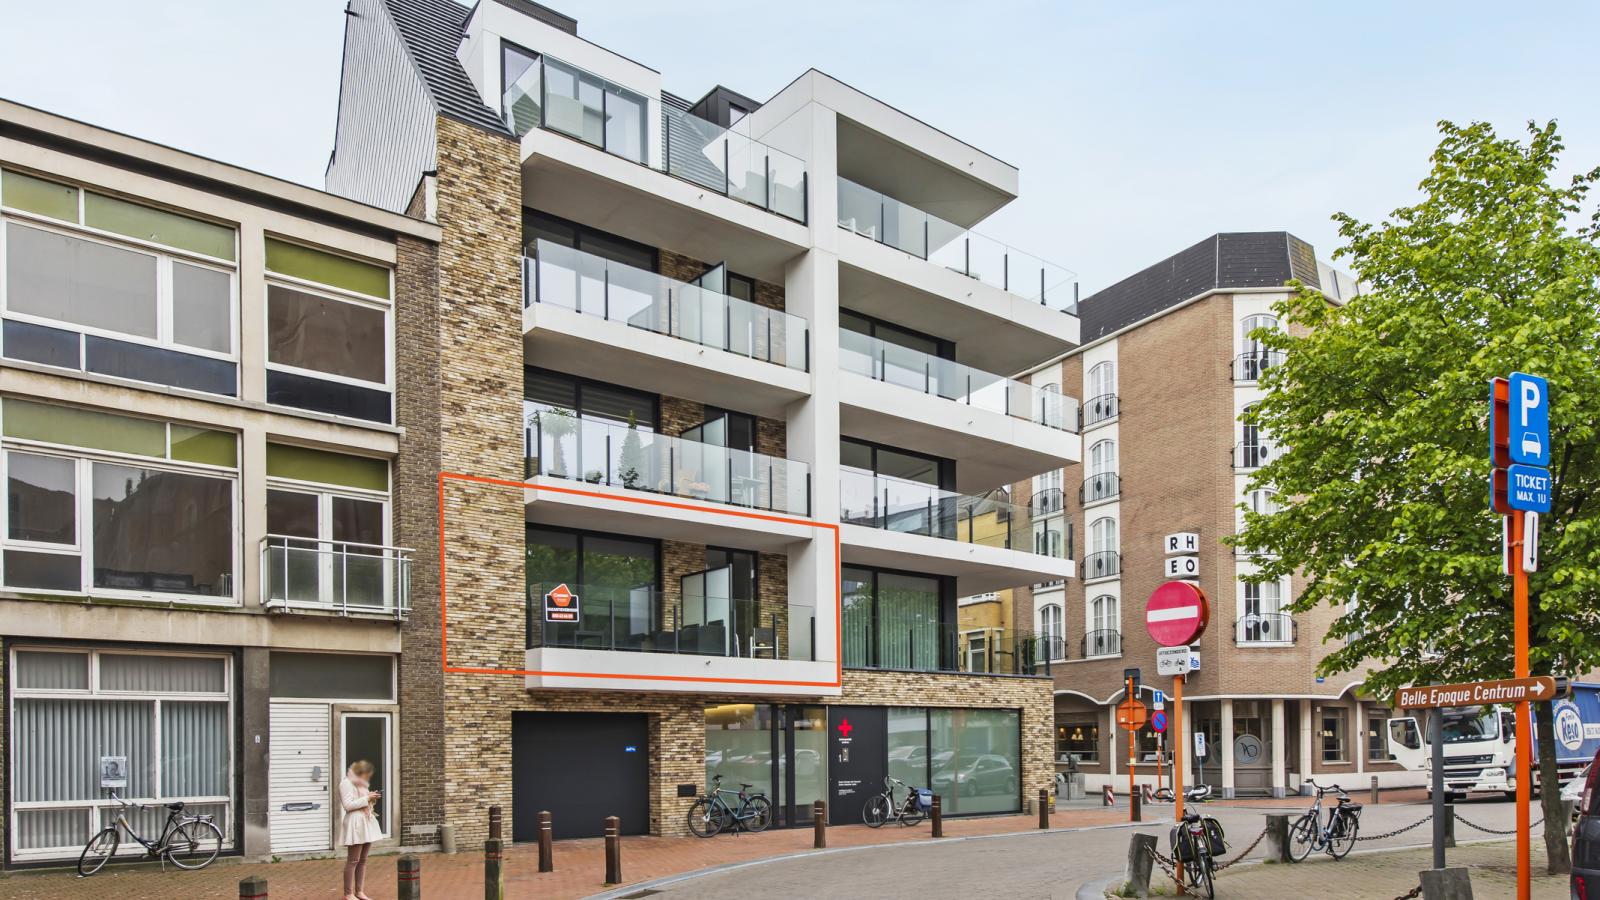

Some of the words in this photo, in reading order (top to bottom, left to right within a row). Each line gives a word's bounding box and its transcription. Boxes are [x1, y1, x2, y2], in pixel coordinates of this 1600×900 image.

[1521, 380, 1540, 427] P
[1515, 473, 1547, 490] TICKET
[1401, 691, 1427, 706] Belle
[1430, 689, 1471, 707] Epoque
[1474, 684, 1526, 700] Centrum
